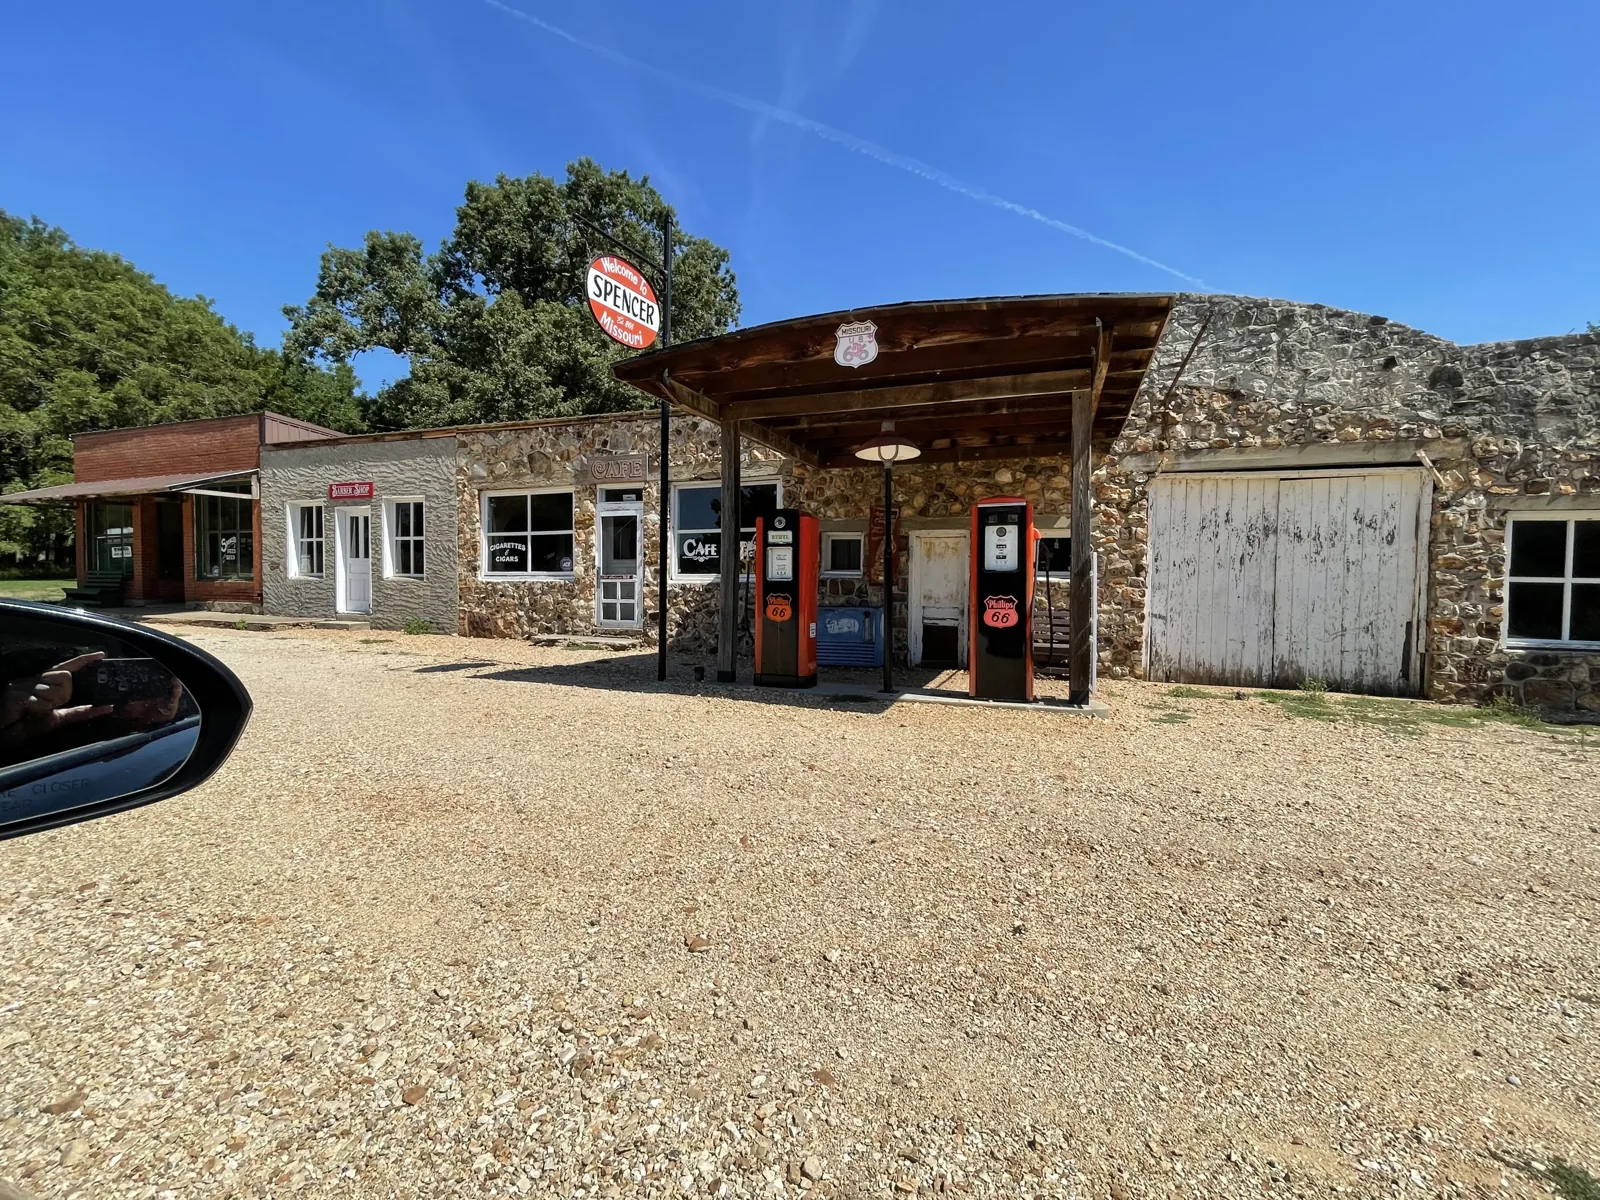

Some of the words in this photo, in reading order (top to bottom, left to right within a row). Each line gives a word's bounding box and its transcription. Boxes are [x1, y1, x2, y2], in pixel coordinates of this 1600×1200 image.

[601, 257, 638, 284] Welcome
[640, 276, 648, 295] To
[593, 274, 654, 325] SPENCER
[600, 311, 643, 345] Missouri
[842, 326, 871, 335] MISSOURI
[592, 460, 642, 479] CAFE
[490, 542, 526, 551] CIGARETTES
[683, 539, 717, 556] CAFE
[772, 607, 786, 618] 66
[988, 600, 1013, 610] Phillips
[991, 612, 1010, 624] 66
[32, 778, 90, 795] CLOSER
